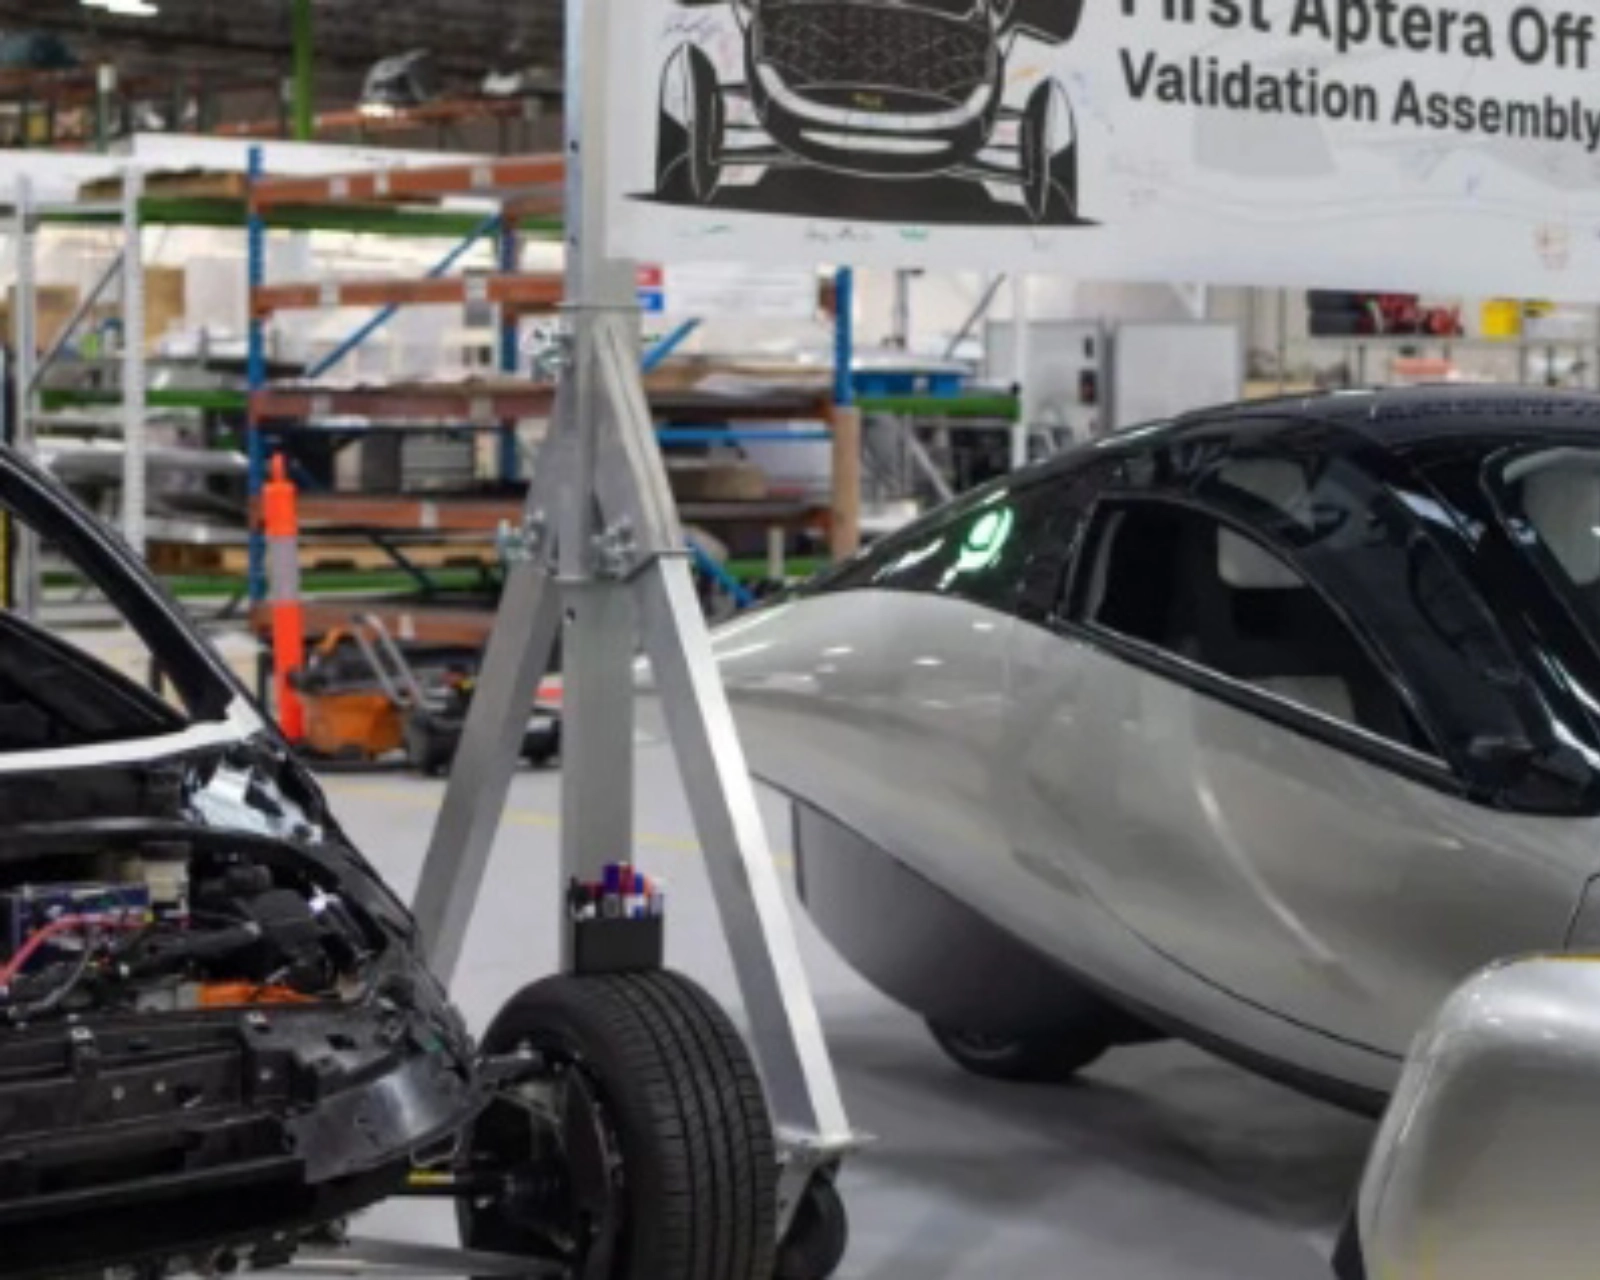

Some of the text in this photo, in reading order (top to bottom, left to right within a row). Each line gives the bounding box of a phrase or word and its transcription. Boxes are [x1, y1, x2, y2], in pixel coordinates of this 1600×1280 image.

[1289, 0, 1493, 59] Aptera
[1508, 6, 1593, 68] Off
[1120, 48, 1377, 122] Validation
